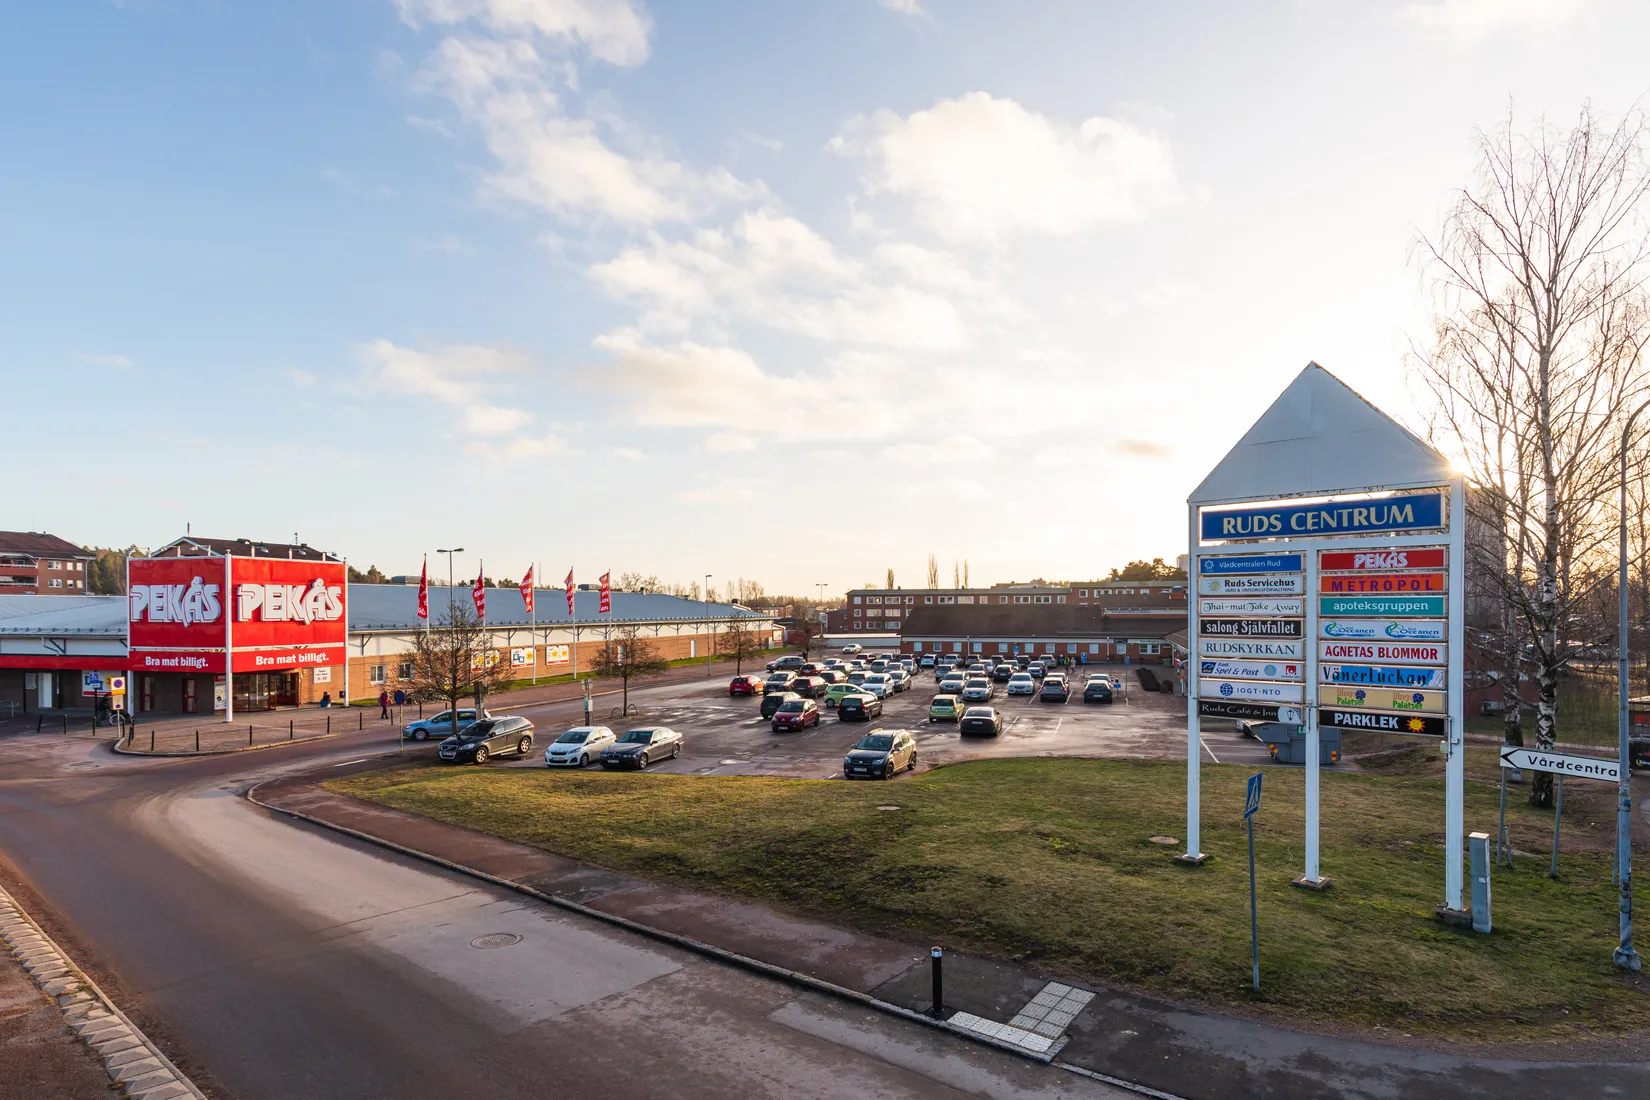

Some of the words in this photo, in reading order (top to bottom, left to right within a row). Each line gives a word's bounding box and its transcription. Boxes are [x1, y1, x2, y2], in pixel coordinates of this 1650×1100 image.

[1223, 514, 1282, 535] RUDS
[1290, 503, 1414, 531] CENTRUM
[1219, 560, 1266, 569] Vårdcentralen
[1354, 551, 1408, 569] PEKÅS
[1224, 579, 1246, 588] Ruds
[1247, 578, 1295, 587] Servicehus
[1331, 579, 1433, 592] METROPOL
[130, 575, 222, 627] PEKÅS
[237, 577, 343, 626] PEKÅS
[1203, 602, 1246, 612] Thai-mat
[1246, 602, 1269, 612] Take
[1271, 603, 1300, 613] Away
[1333, 601, 1429, 612] apoteksgruppen
[1206, 620, 1239, 635] salong
[1241, 620, 1295, 635] Självfallet
[1206, 643, 1296, 655] RUDSKYRKAN
[1325, 645, 1374, 658] AGNETAS
[1377, 647, 1438, 660] BLOMMOR
[145, 656, 160, 666] Bra
[161, 657, 180, 666] mat
[180, 656, 209, 669] billigt.
[255, 655, 274, 666] Bra
[279, 655, 297, 665] mat
[298, 652, 330, 664] billigt.
[1214, 666, 1232, 675] Spel
[1241, 668, 1259, 676] Post
[1236, 687, 1281, 696] IOGT-NTO
[1336, 696, 1365, 705] Palatset
[1392, 699, 1423, 710] Palatset
[1202, 704, 1225, 712] Ruds
[1227, 705, 1251, 715] Café
[1262, 708, 1277, 716] Inn
[1334, 712, 1399, 729] PARKLEK
[1527, 755, 1618, 777] Vårdcentra
